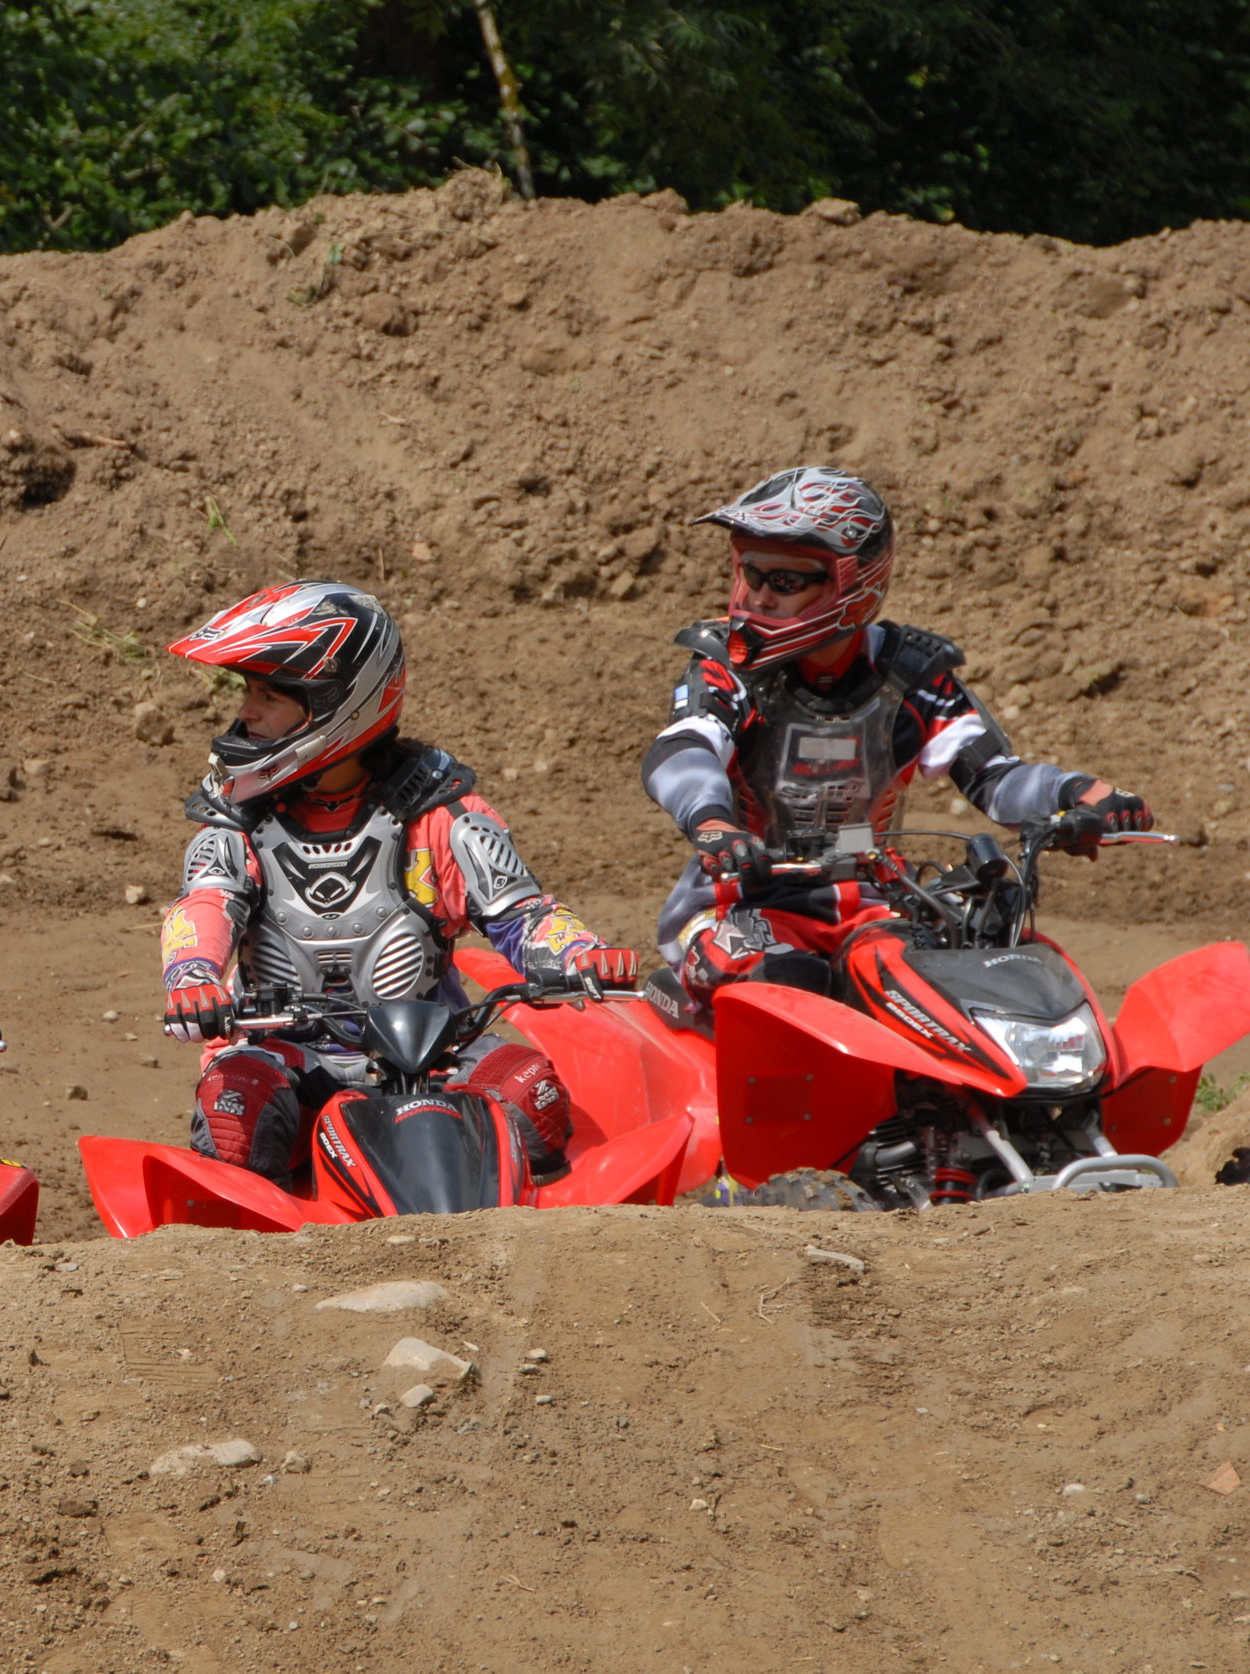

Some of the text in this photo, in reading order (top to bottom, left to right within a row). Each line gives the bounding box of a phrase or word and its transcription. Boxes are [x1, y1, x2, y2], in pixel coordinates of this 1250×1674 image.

[982, 954, 1043, 968] HONDA
[645, 980, 680, 1019] HONDA
[884, 990, 972, 1052] SPORTRAX
[396, 1099, 460, 1116] HONDA
[323, 1115, 357, 1167] SPORTRAX
